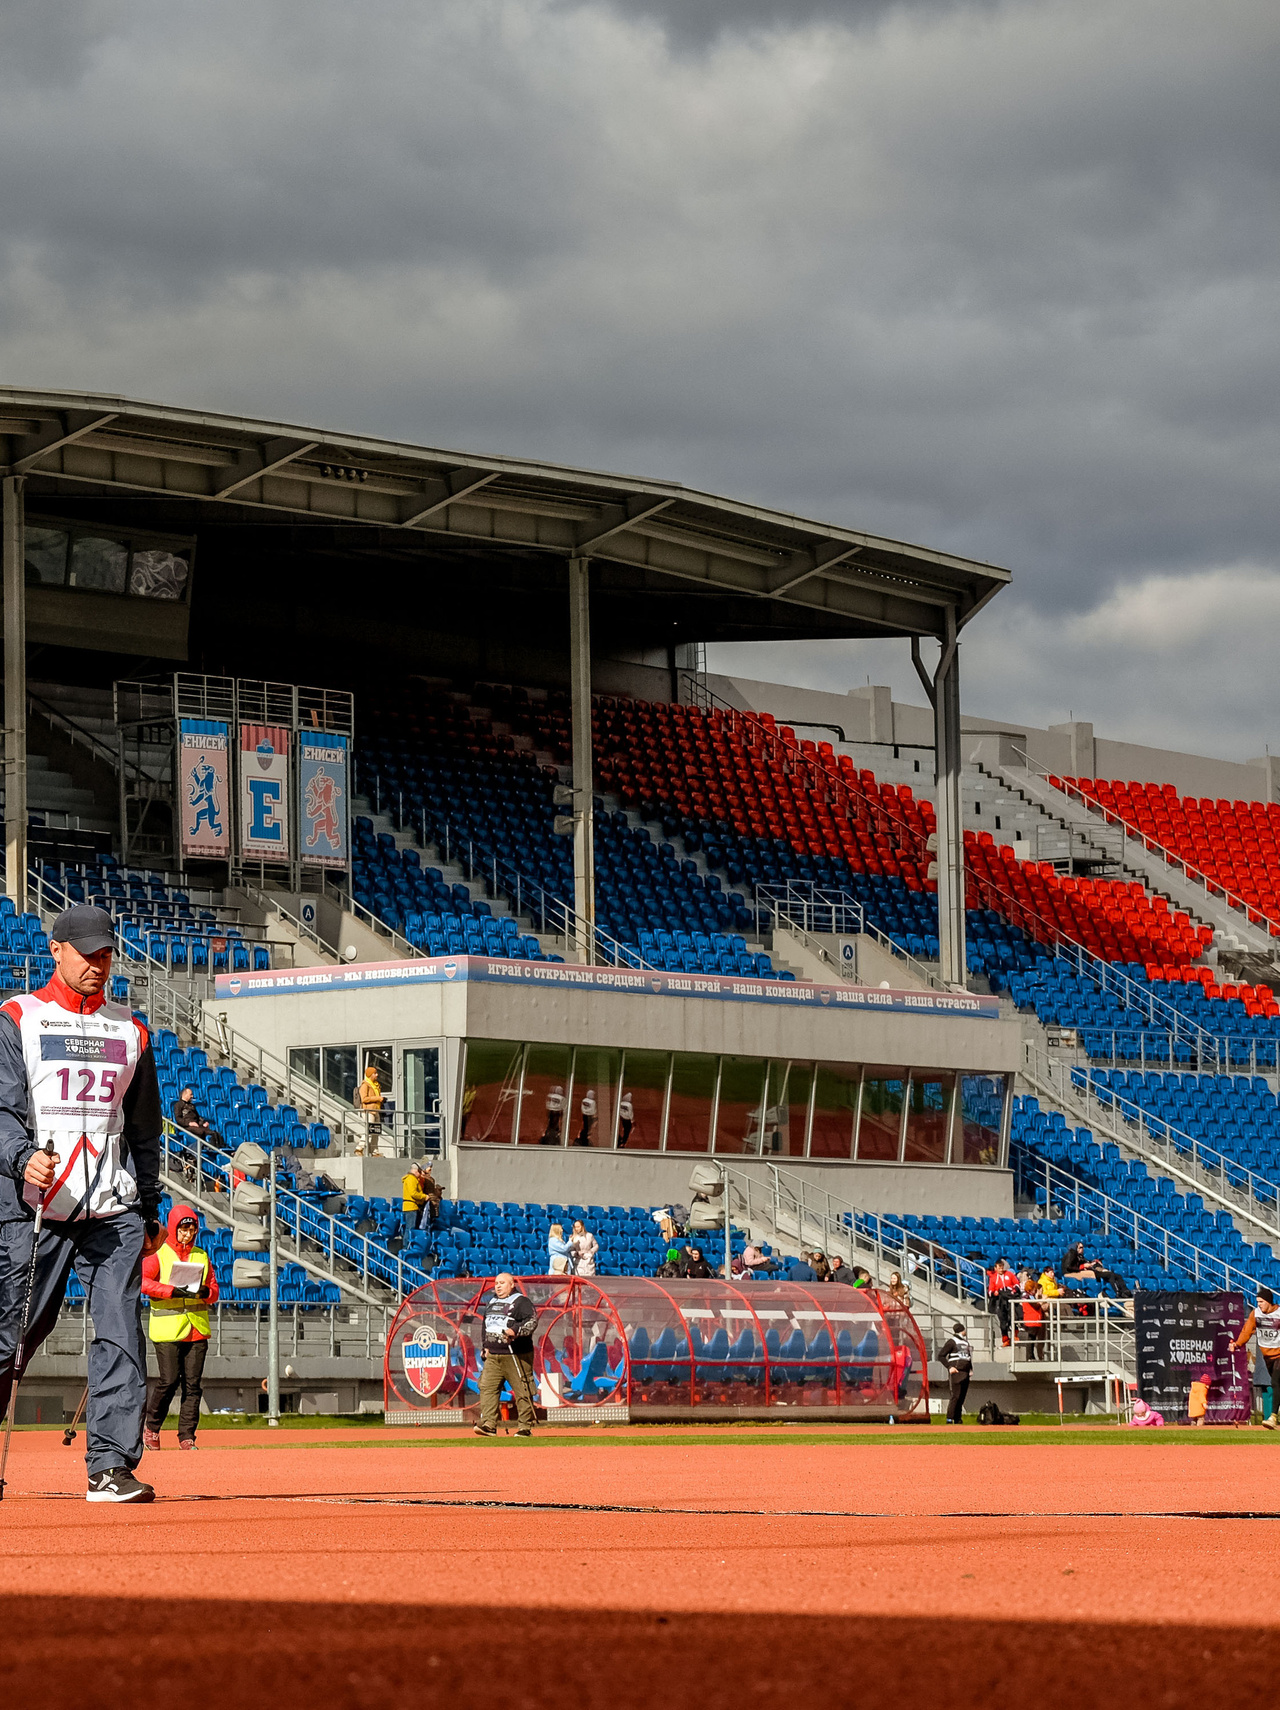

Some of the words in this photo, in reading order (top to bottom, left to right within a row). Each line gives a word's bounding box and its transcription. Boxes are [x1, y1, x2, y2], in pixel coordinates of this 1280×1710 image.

[183, 733, 226, 750] ЕНИСЕЙ
[303, 745, 344, 764] ЕНИСЕЙ
[64, 1038, 105, 1047] СЕВЕРНАЯ
[56, 1067, 118, 1103] 125
[1169, 1339, 1214, 1352] СЕВЕРНАЯ
[404, 1354, 447, 1369] ЕНИСЕЙ
